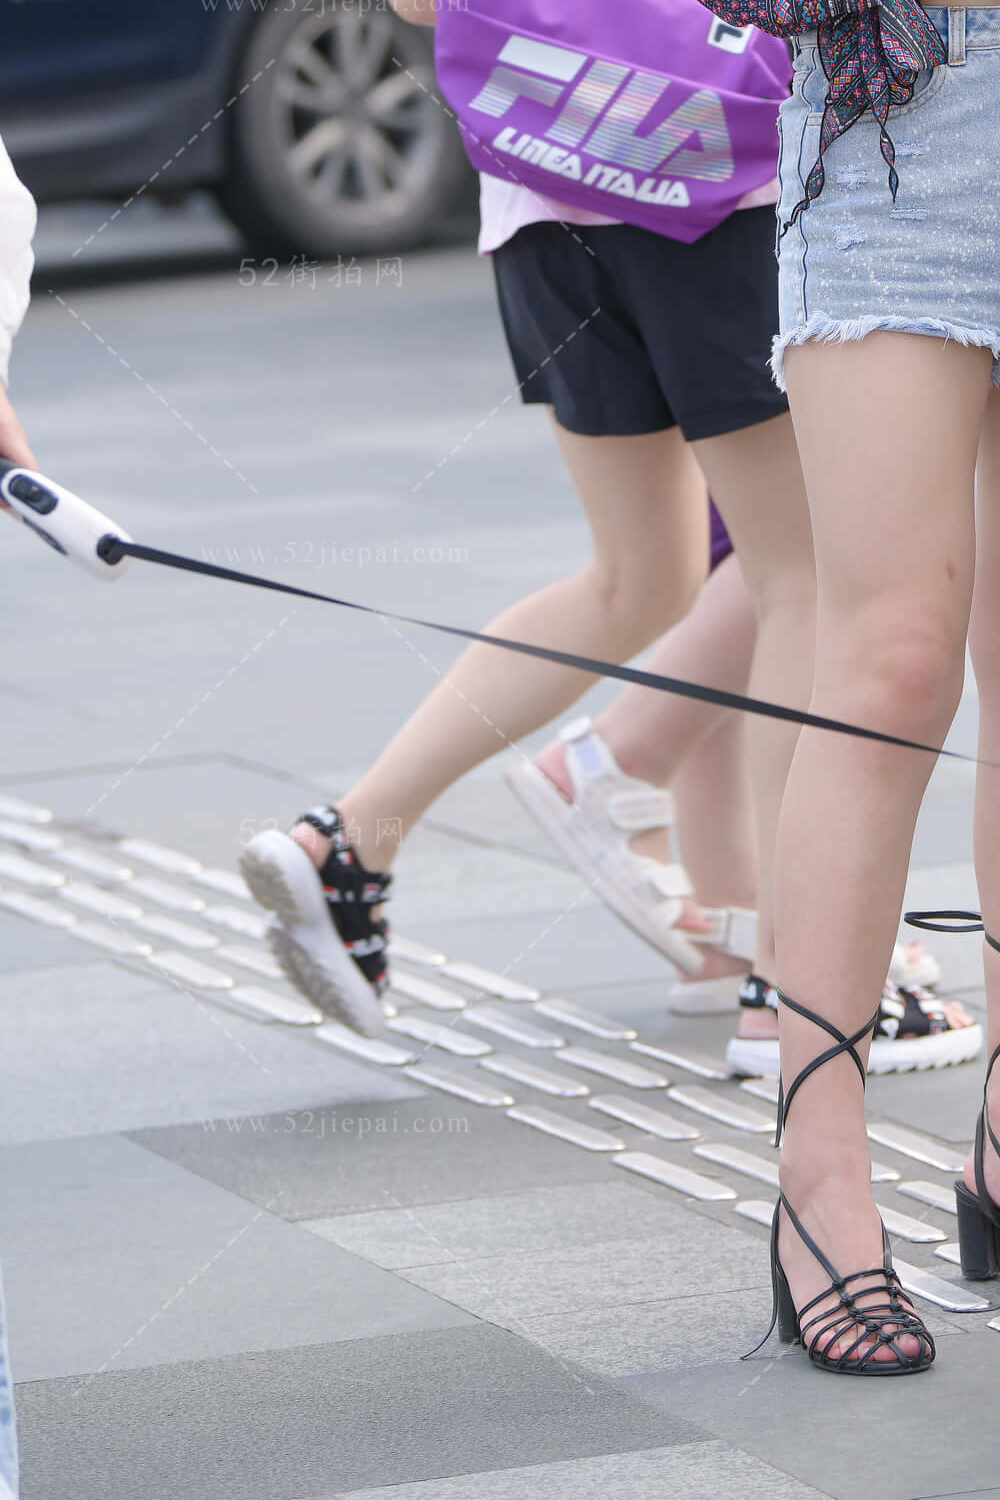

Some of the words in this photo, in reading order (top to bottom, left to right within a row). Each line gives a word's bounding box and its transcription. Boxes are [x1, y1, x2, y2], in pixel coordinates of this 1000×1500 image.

[469, 34, 735, 182] FILA
[492, 126, 583, 181] LINEA
[582, 162, 691, 208] ITALIA
